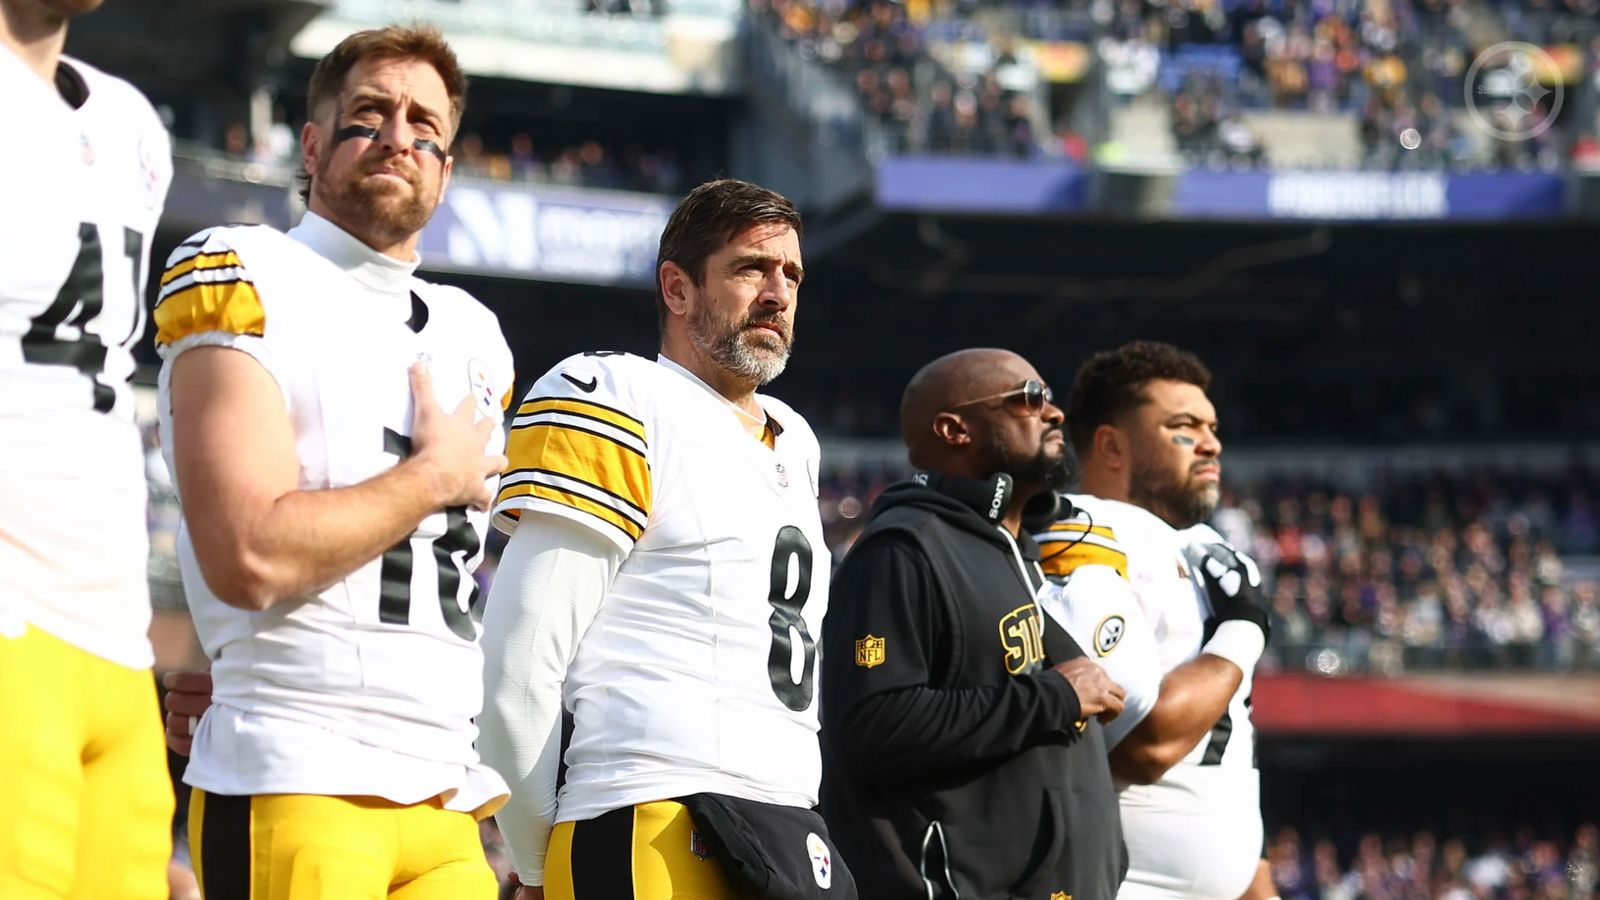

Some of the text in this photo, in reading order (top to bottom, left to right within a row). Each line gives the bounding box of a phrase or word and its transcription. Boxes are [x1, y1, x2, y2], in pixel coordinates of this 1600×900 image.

[989, 476, 1006, 519] SONY
[768, 525, 816, 712] 8
[858, 649, 881, 663] NFL
